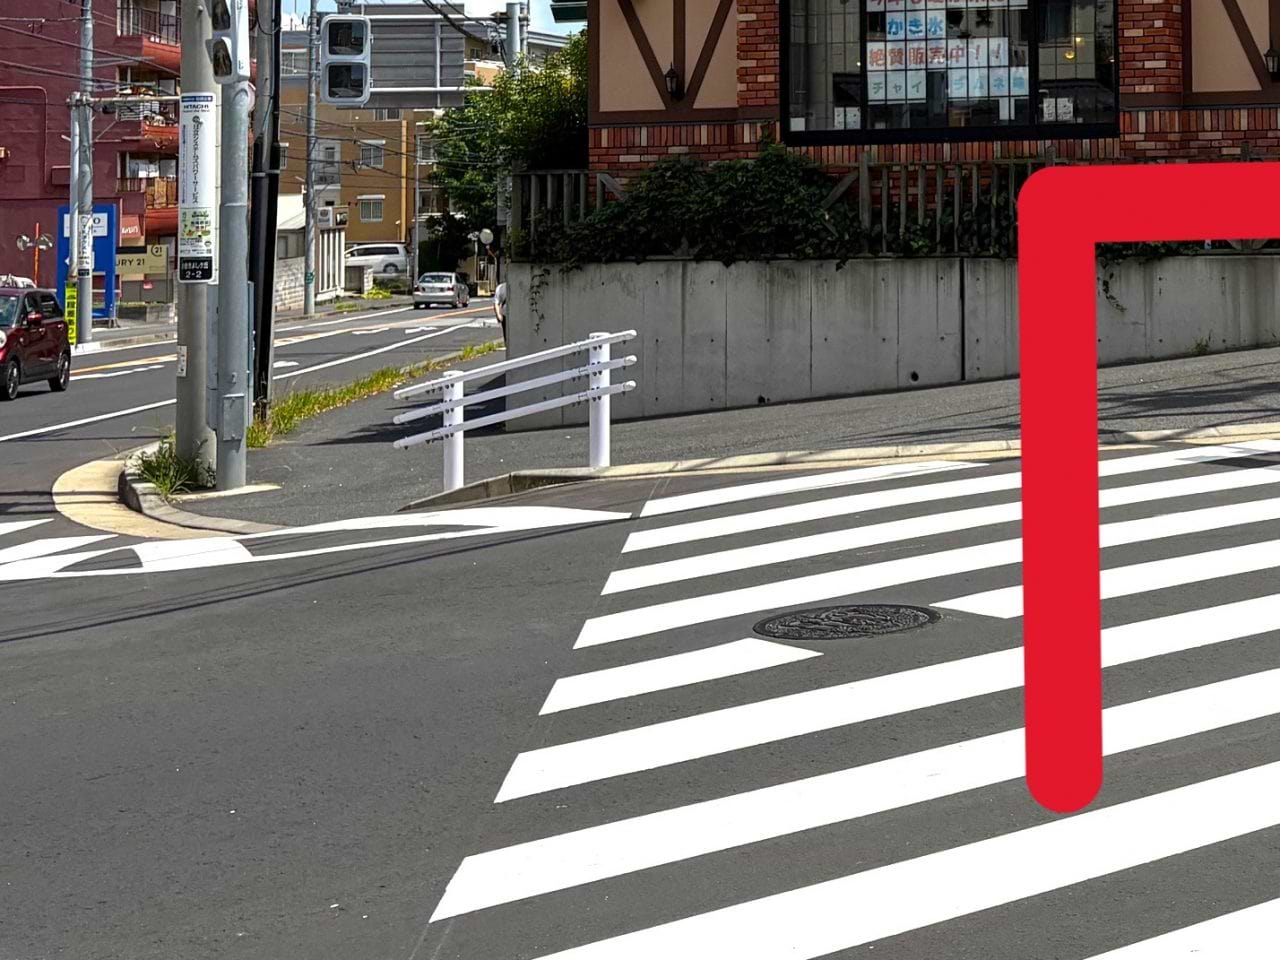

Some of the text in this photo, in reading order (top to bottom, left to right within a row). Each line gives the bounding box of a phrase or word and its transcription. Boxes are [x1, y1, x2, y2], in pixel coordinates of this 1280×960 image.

[887, 13, 944, 37] かき氷
[872, 80, 923, 95] チャイ
[136, 258, 145, 266] 21
[185, 271, 202, 279] 2-2
